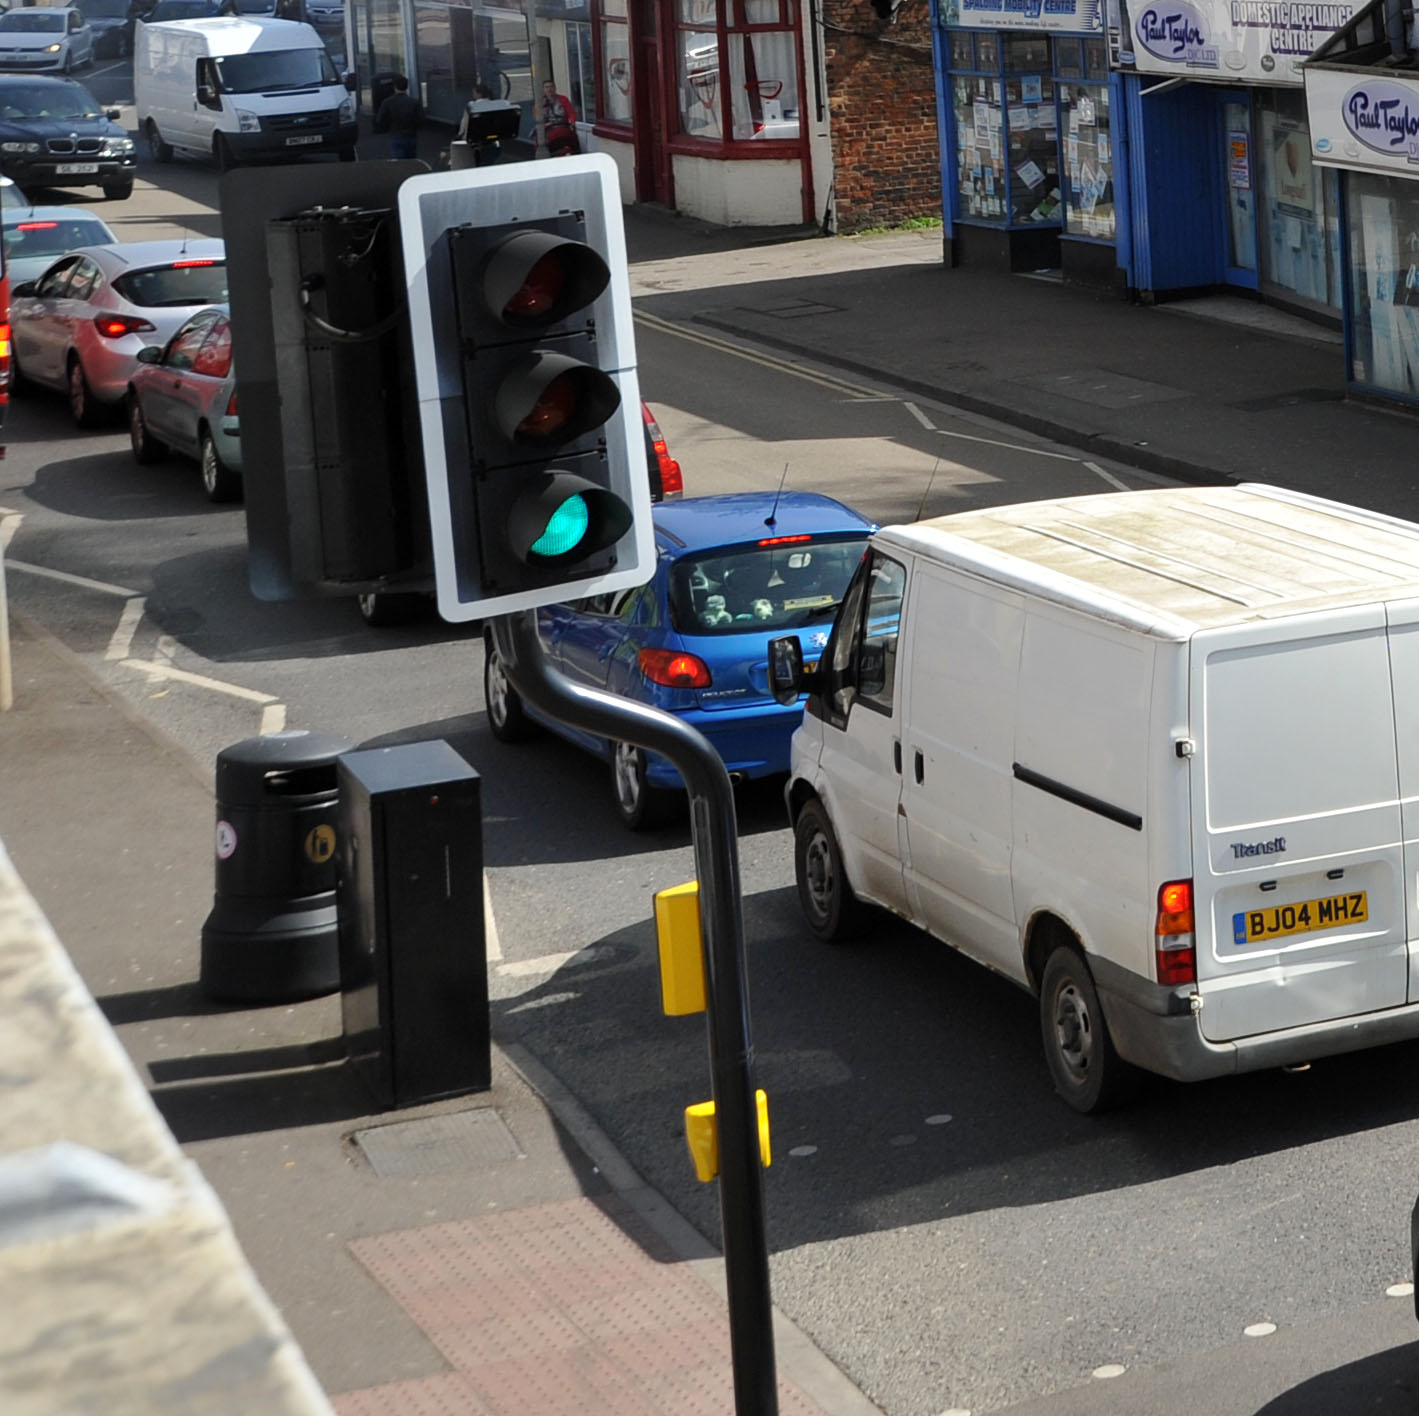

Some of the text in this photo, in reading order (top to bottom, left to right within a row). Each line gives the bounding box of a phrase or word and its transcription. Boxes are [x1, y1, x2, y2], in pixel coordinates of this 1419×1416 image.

[1044, 0, 1077, 14] CENTRE
[1231, 0, 1289, 29] DOMESTIC
[1142, 10, 1205, 53] Paul Taylor
[1271, 28, 1314, 56] CENTRE
[1350, 92, 1381, 130] Paul
[1230, 837, 1286, 859] Transit
[1250, 894, 1364, 936] BJ04 MHZ
